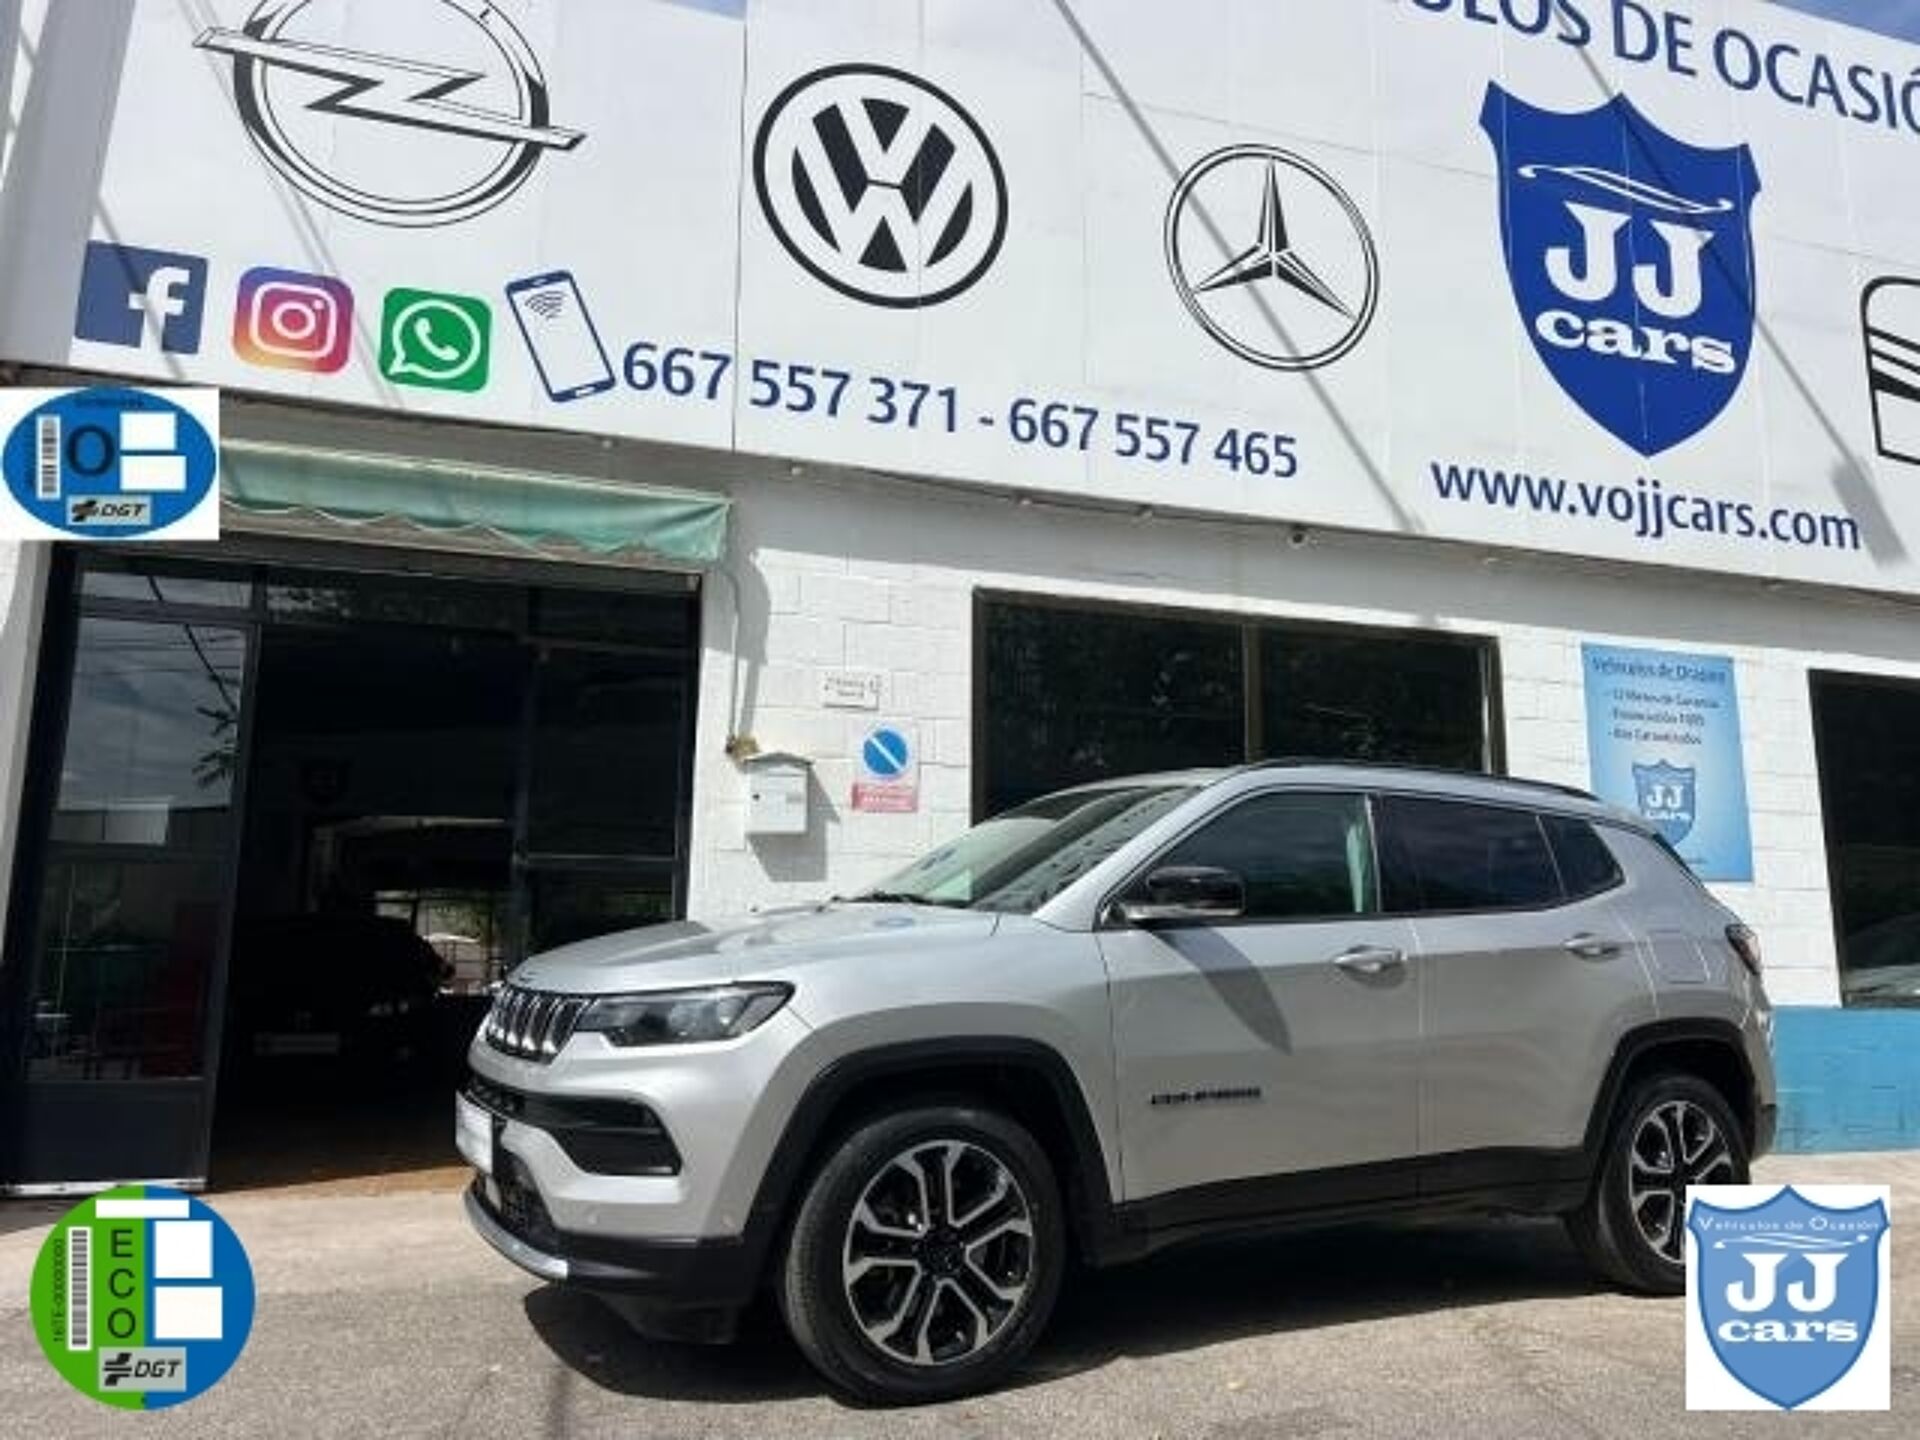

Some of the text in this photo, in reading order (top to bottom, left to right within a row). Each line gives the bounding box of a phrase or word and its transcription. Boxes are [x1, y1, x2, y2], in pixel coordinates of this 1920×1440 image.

[1613, 0, 1697, 77] DE
[1544, 201, 1715, 319] JJ
[1535, 309, 1737, 374] cars
[623, 341, 731, 400] 667
[750, 359, 851, 417] 557
[867, 377, 957, 433] 371
[1008, 398, 1099, 450] 667
[1114, 413, 1201, 465] 557
[1214, 428, 1297, 478] 465
[1430, 462, 1860, 550] www.vojjcars.com
[1646, 785, 1684, 808] JJ
